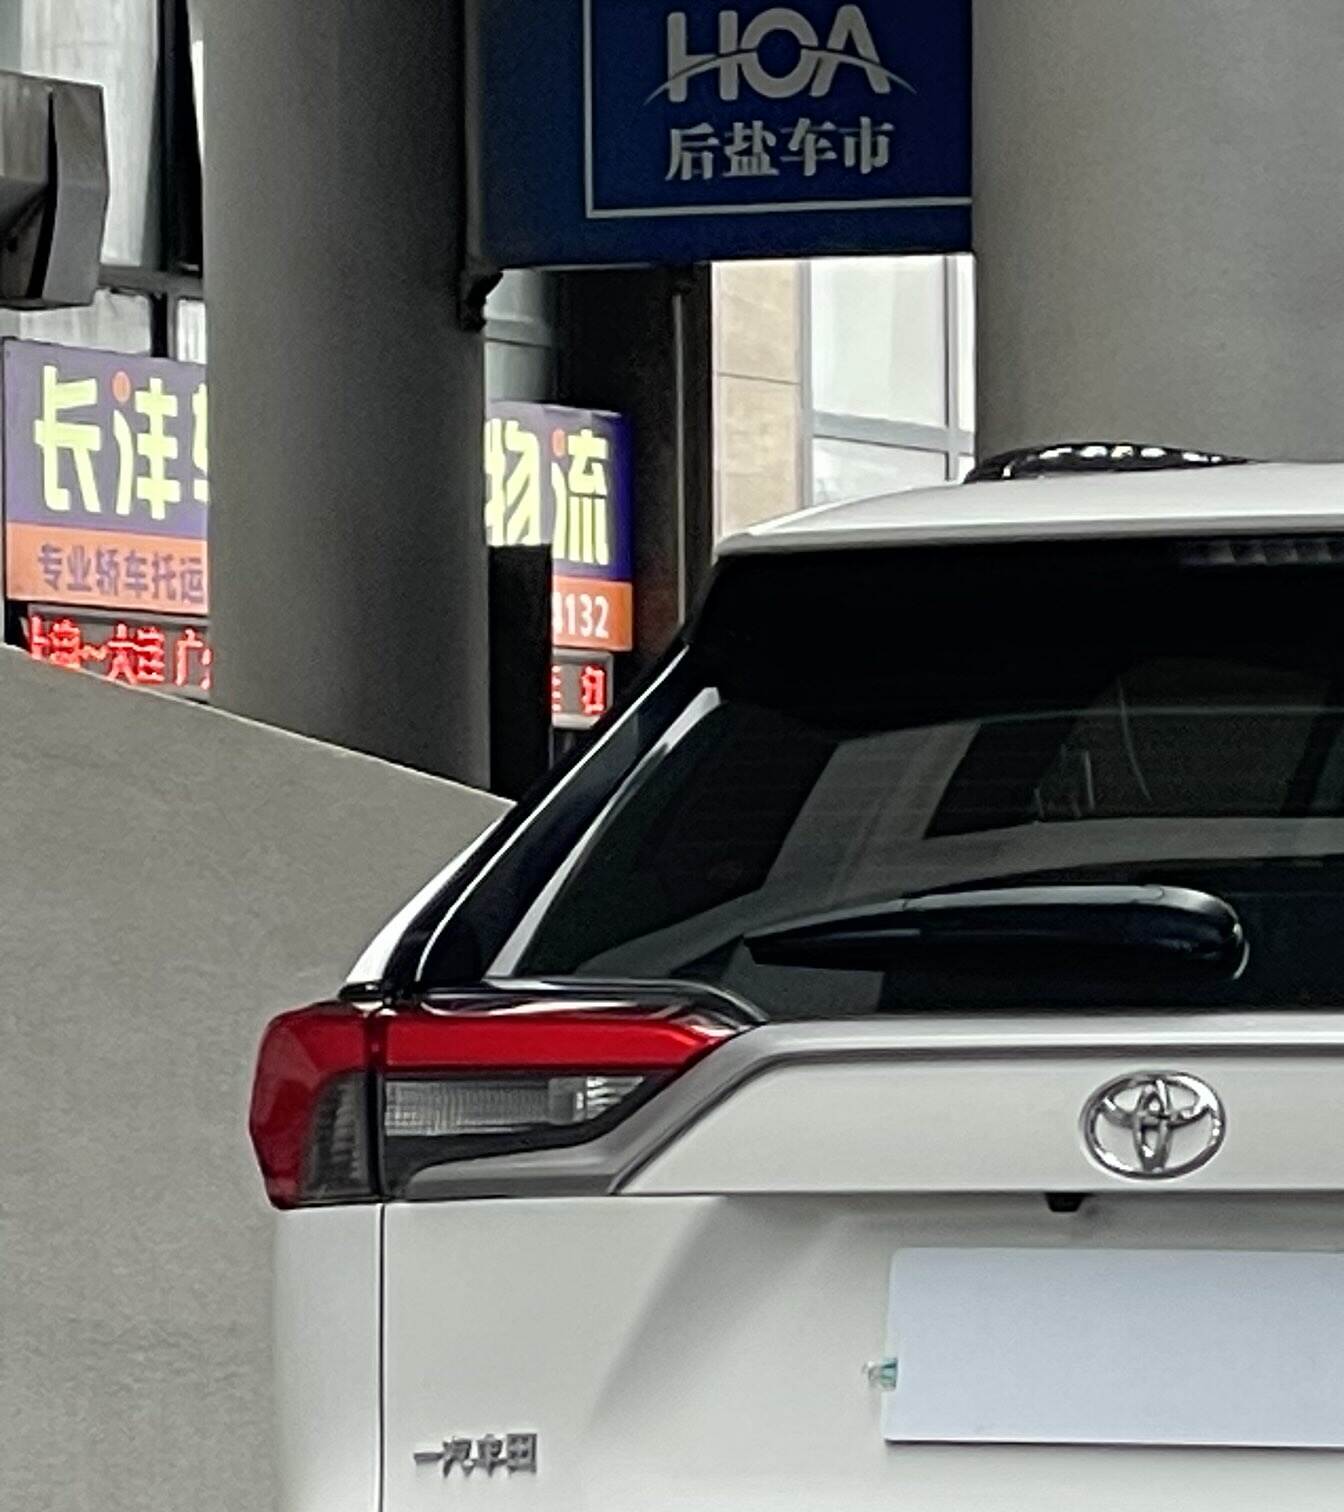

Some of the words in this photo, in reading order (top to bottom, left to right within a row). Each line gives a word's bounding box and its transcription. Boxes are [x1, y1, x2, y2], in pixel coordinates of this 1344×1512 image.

[666, 4, 892, 103] HOA
[664, 116, 896, 181] 后盐车市
[37, 543, 205, 604] 专业轿车托运
